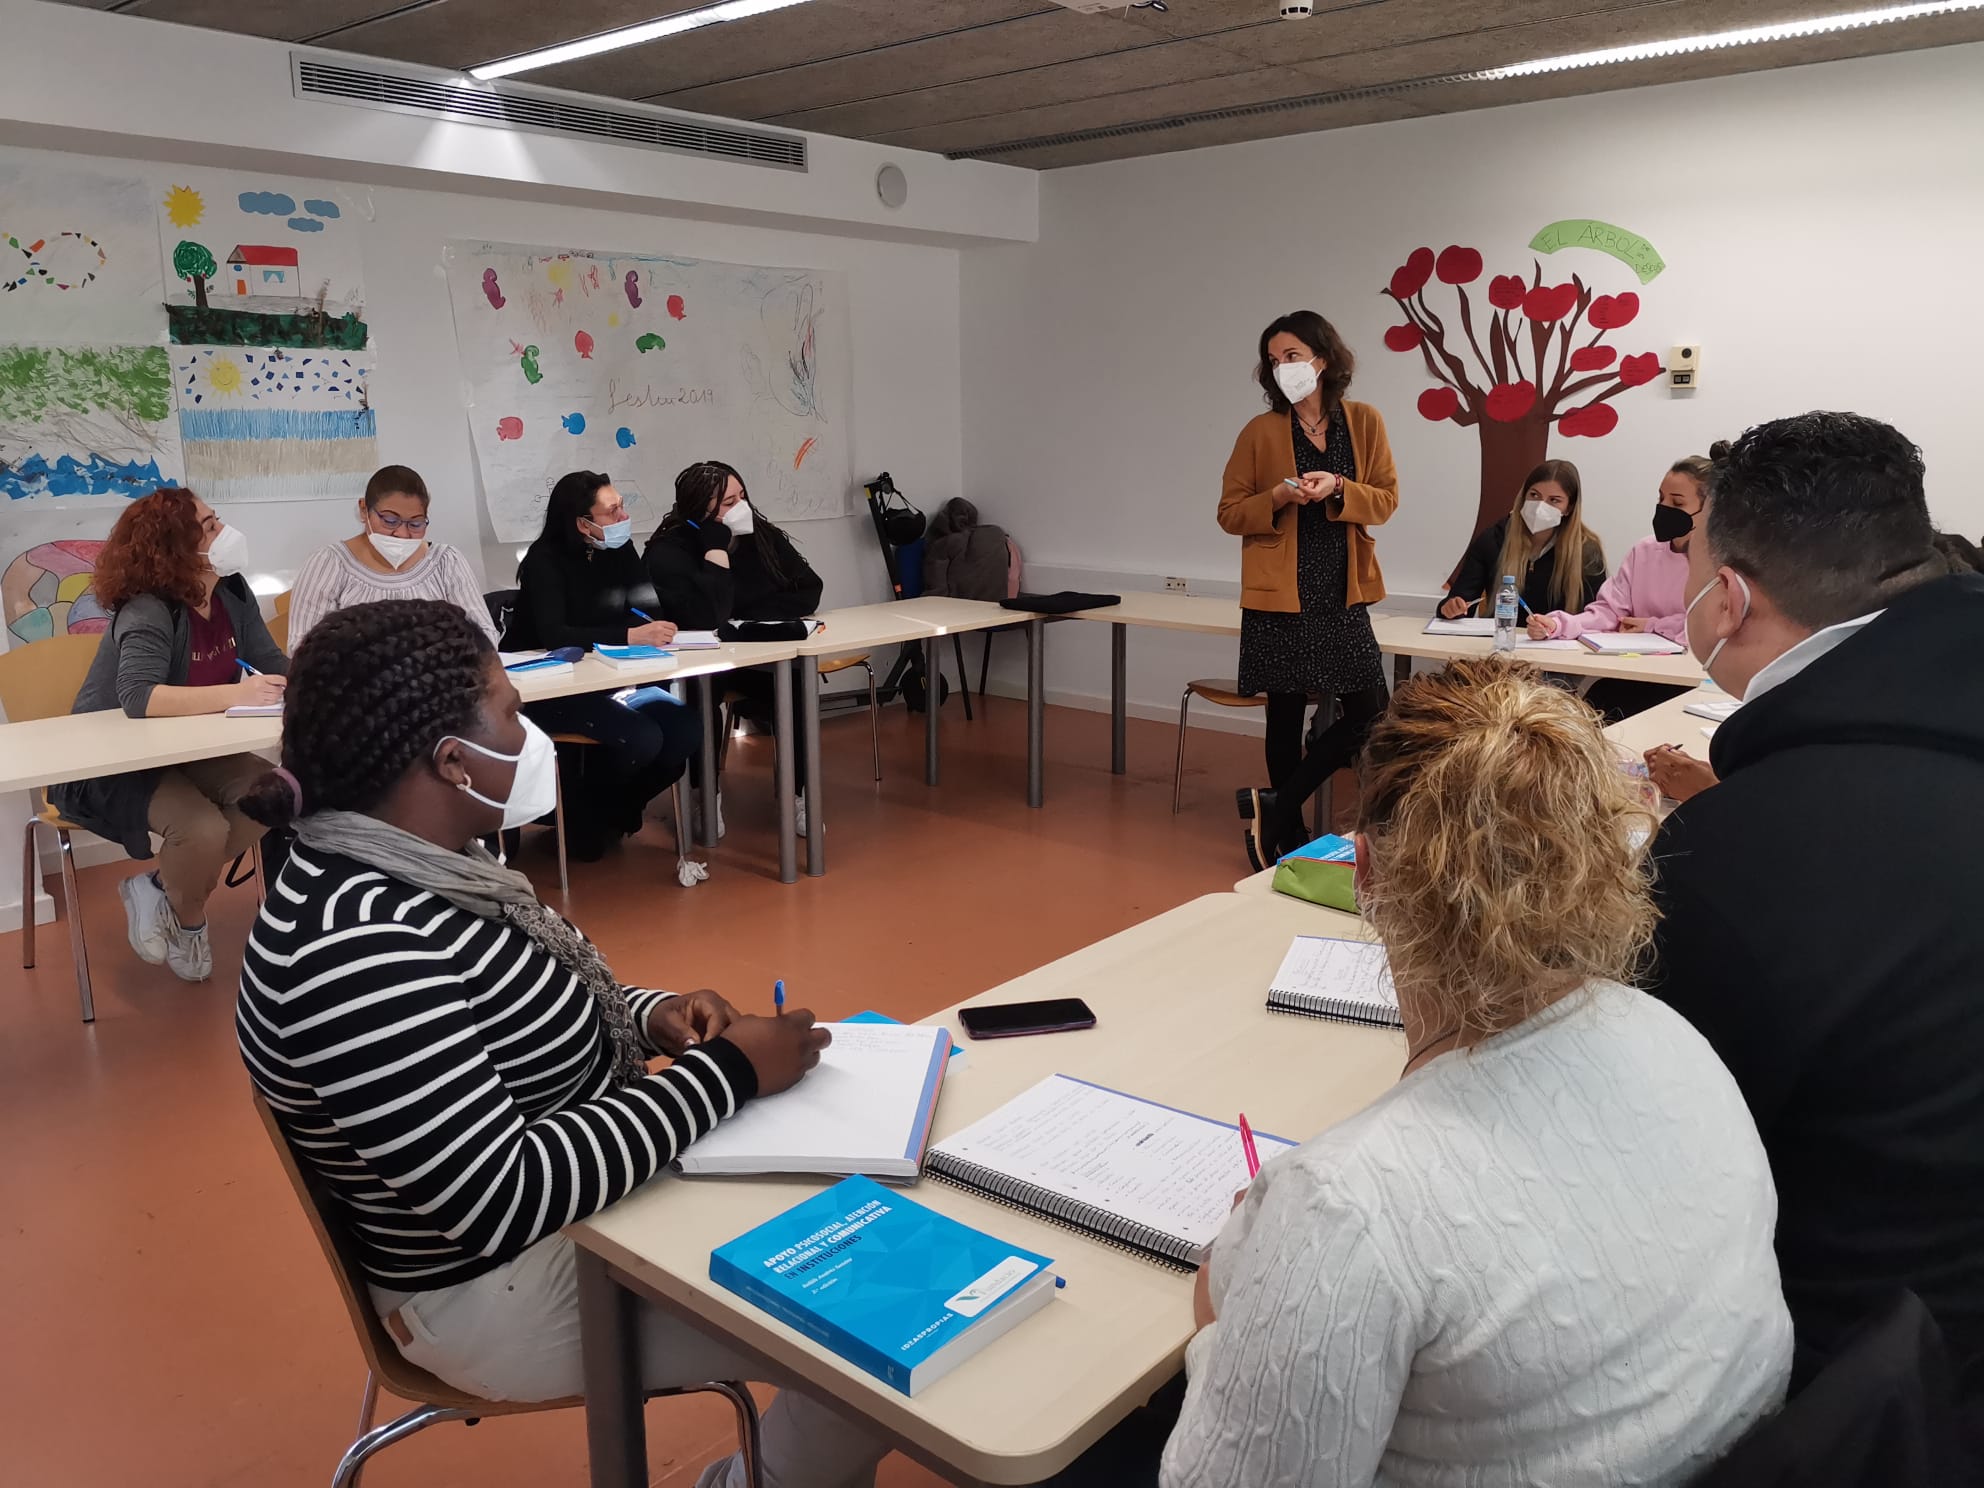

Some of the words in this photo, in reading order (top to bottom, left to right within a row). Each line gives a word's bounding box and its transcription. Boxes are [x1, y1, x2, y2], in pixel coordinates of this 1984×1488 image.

[1541, 229, 1568, 250] EL
[763, 1247, 797, 1268] APOYO
[794, 1221, 848, 1250] PSICOSOCIAL,
[772, 1245, 824, 1274] RELACIONAL
[819, 1241, 829, 1256] Y
[827, 1205, 893, 1244] COMUNICATIVA
[783, 1268, 799, 1280] EN
[796, 1235, 862, 1274] INSTITUCIONES
